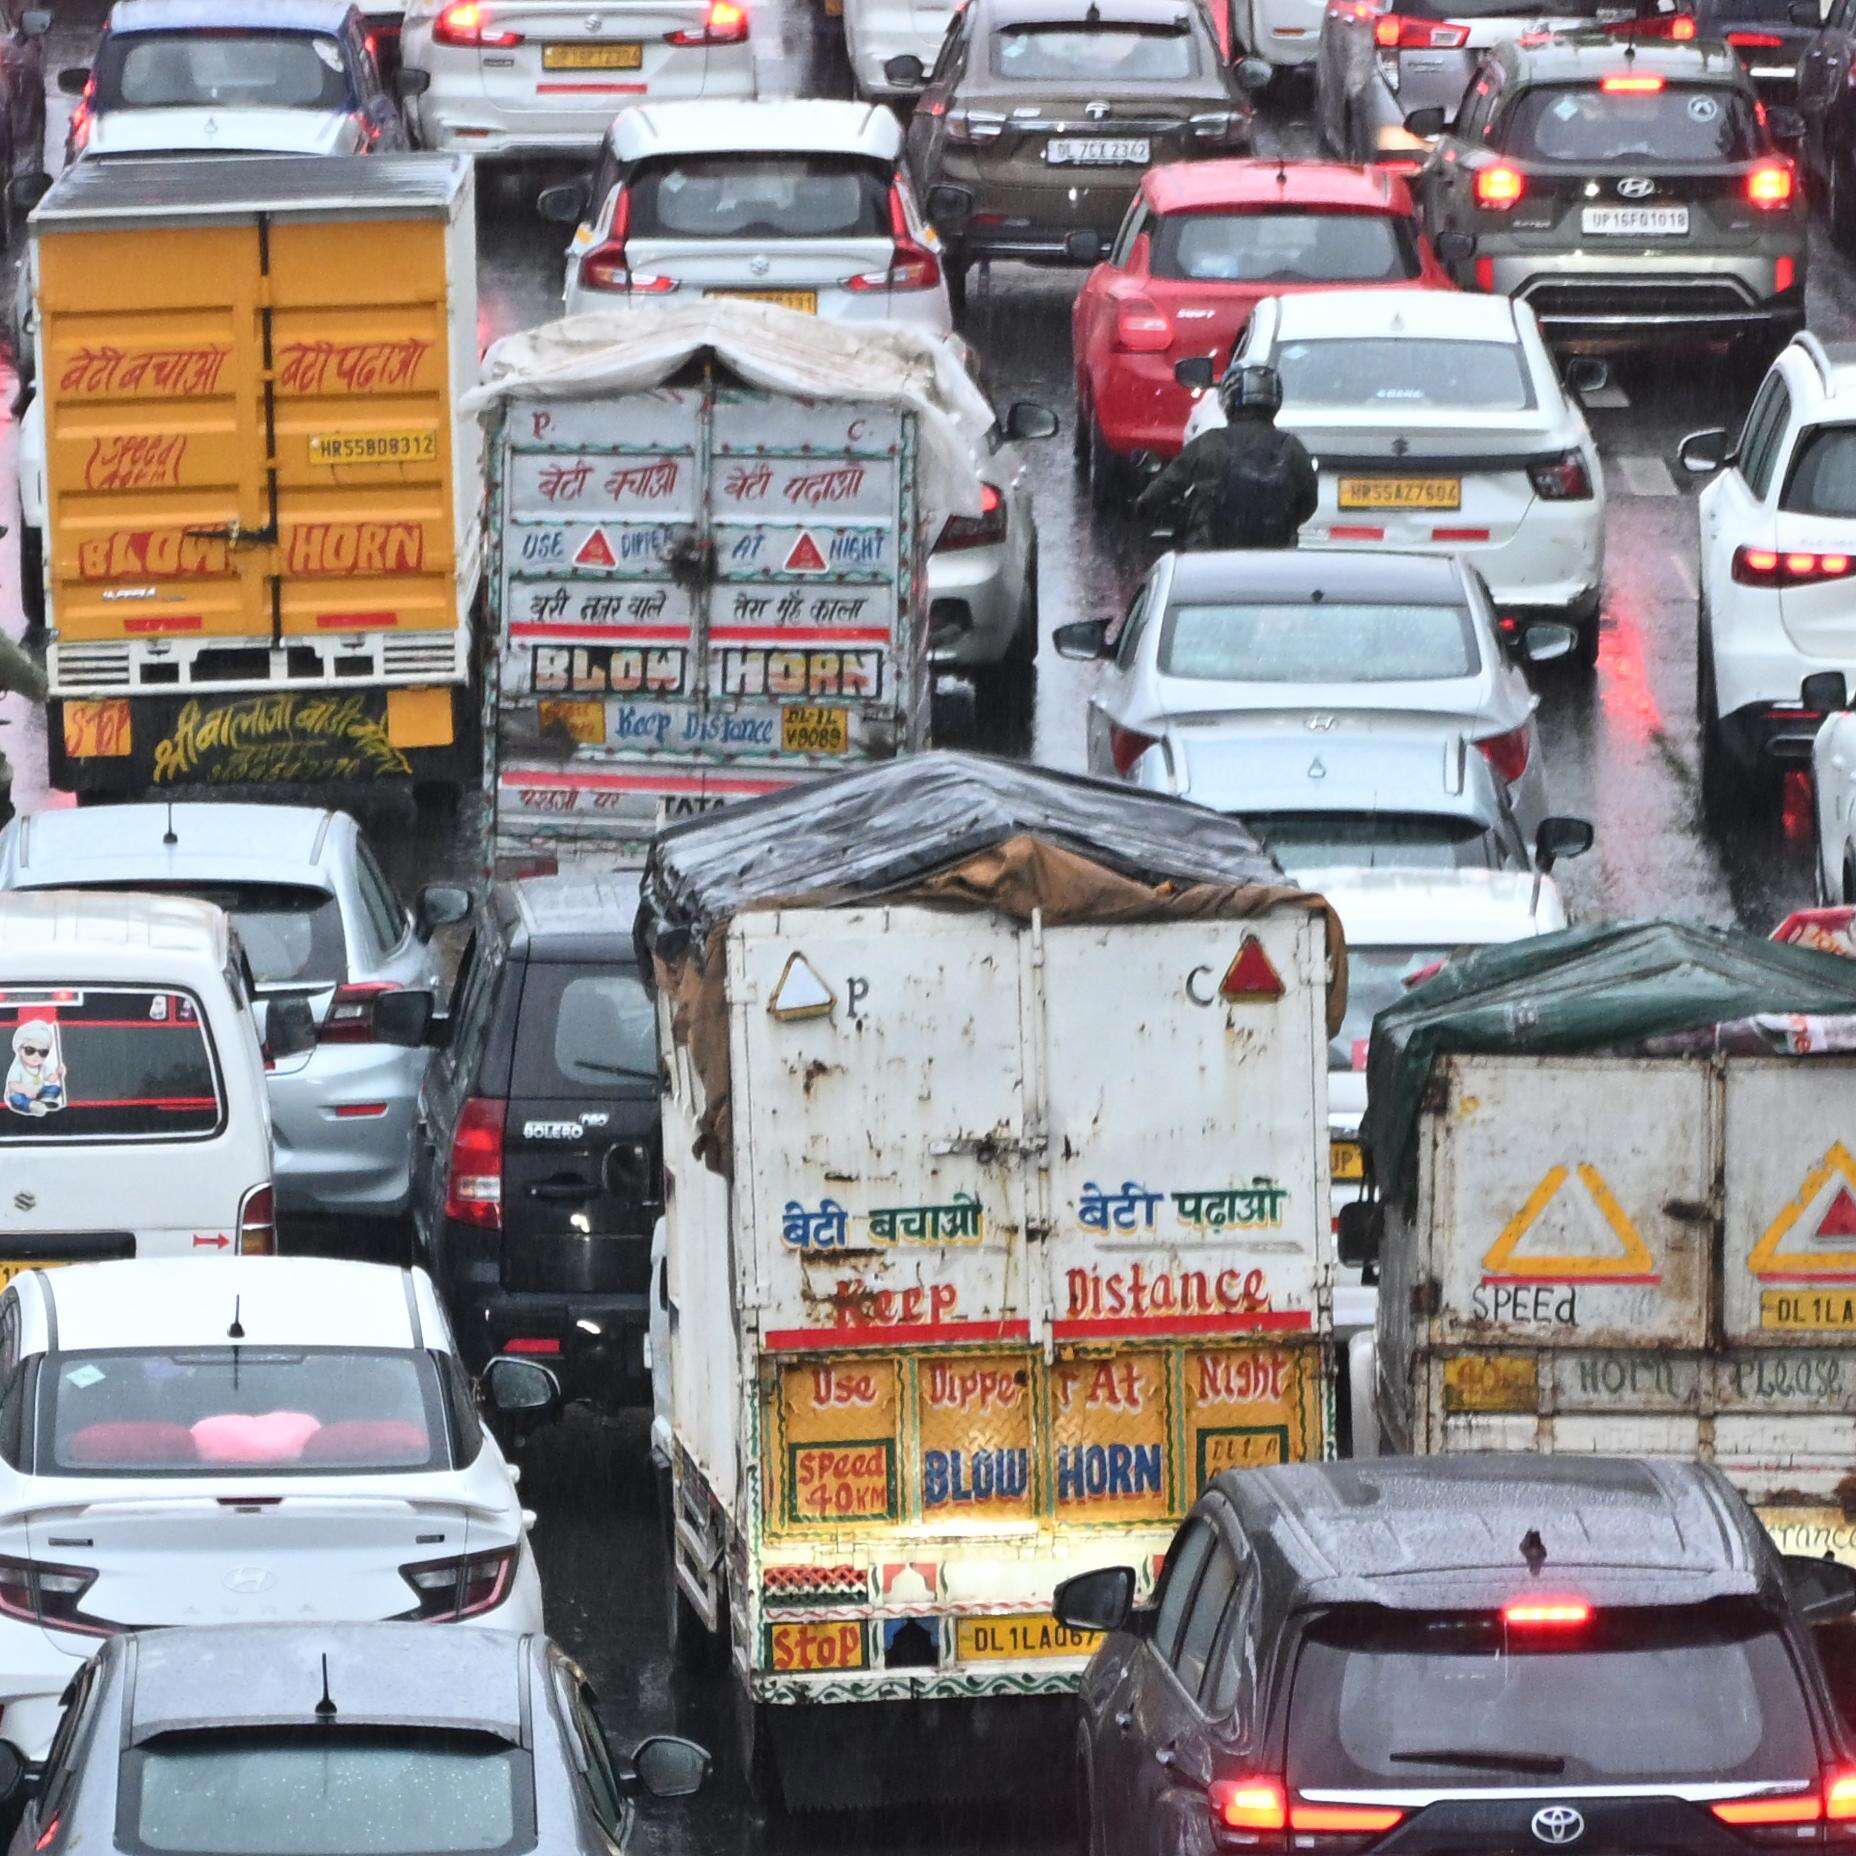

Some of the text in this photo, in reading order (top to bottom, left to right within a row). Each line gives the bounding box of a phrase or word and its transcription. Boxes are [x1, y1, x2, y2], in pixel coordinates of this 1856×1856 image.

[289, 523, 423, 574] HORN
[521, 532, 564, 559] USE
[731, 533, 768, 560] AT
[828, 531, 885, 560] NIGHT
[535, 647, 881, 697] BLOW HORN
[847, 976, 870, 1019] P
[1185, 966, 1216, 1007] C
[524, 1120, 584, 1140] BOLERO
[783, 1177, 1289, 1254] बेटी बचाओ बेटी पढ़ाओ
[834, 1261, 1272, 1329] Keep Distance
[811, 1367, 878, 1407] Use
[1087, 1363, 1145, 1411] At
[1197, 1353, 1287, 1404] Night
[923, 1443, 1163, 1506] BLOW HORN
[774, 1624, 861, 1671] Stop
